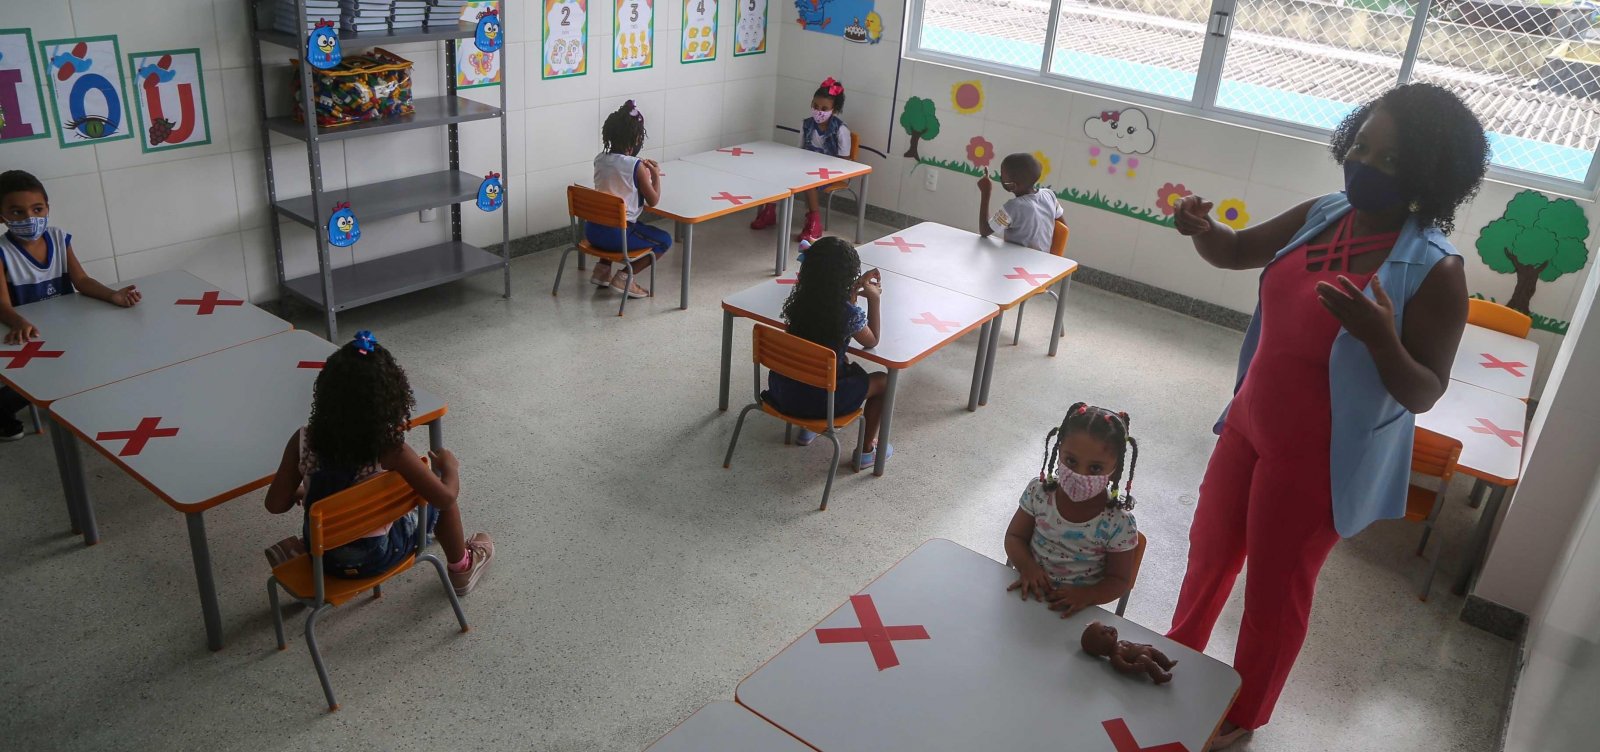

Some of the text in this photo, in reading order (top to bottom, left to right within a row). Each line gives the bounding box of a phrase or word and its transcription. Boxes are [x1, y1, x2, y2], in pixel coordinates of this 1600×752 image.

[630, 3, 639, 22] 3
[696, 0, 706, 15] 4
[748, 0, 756, 11] 5
[560, 6, 571, 26] 2
[69, 73, 121, 138] O
[145, 83, 196, 144] U
